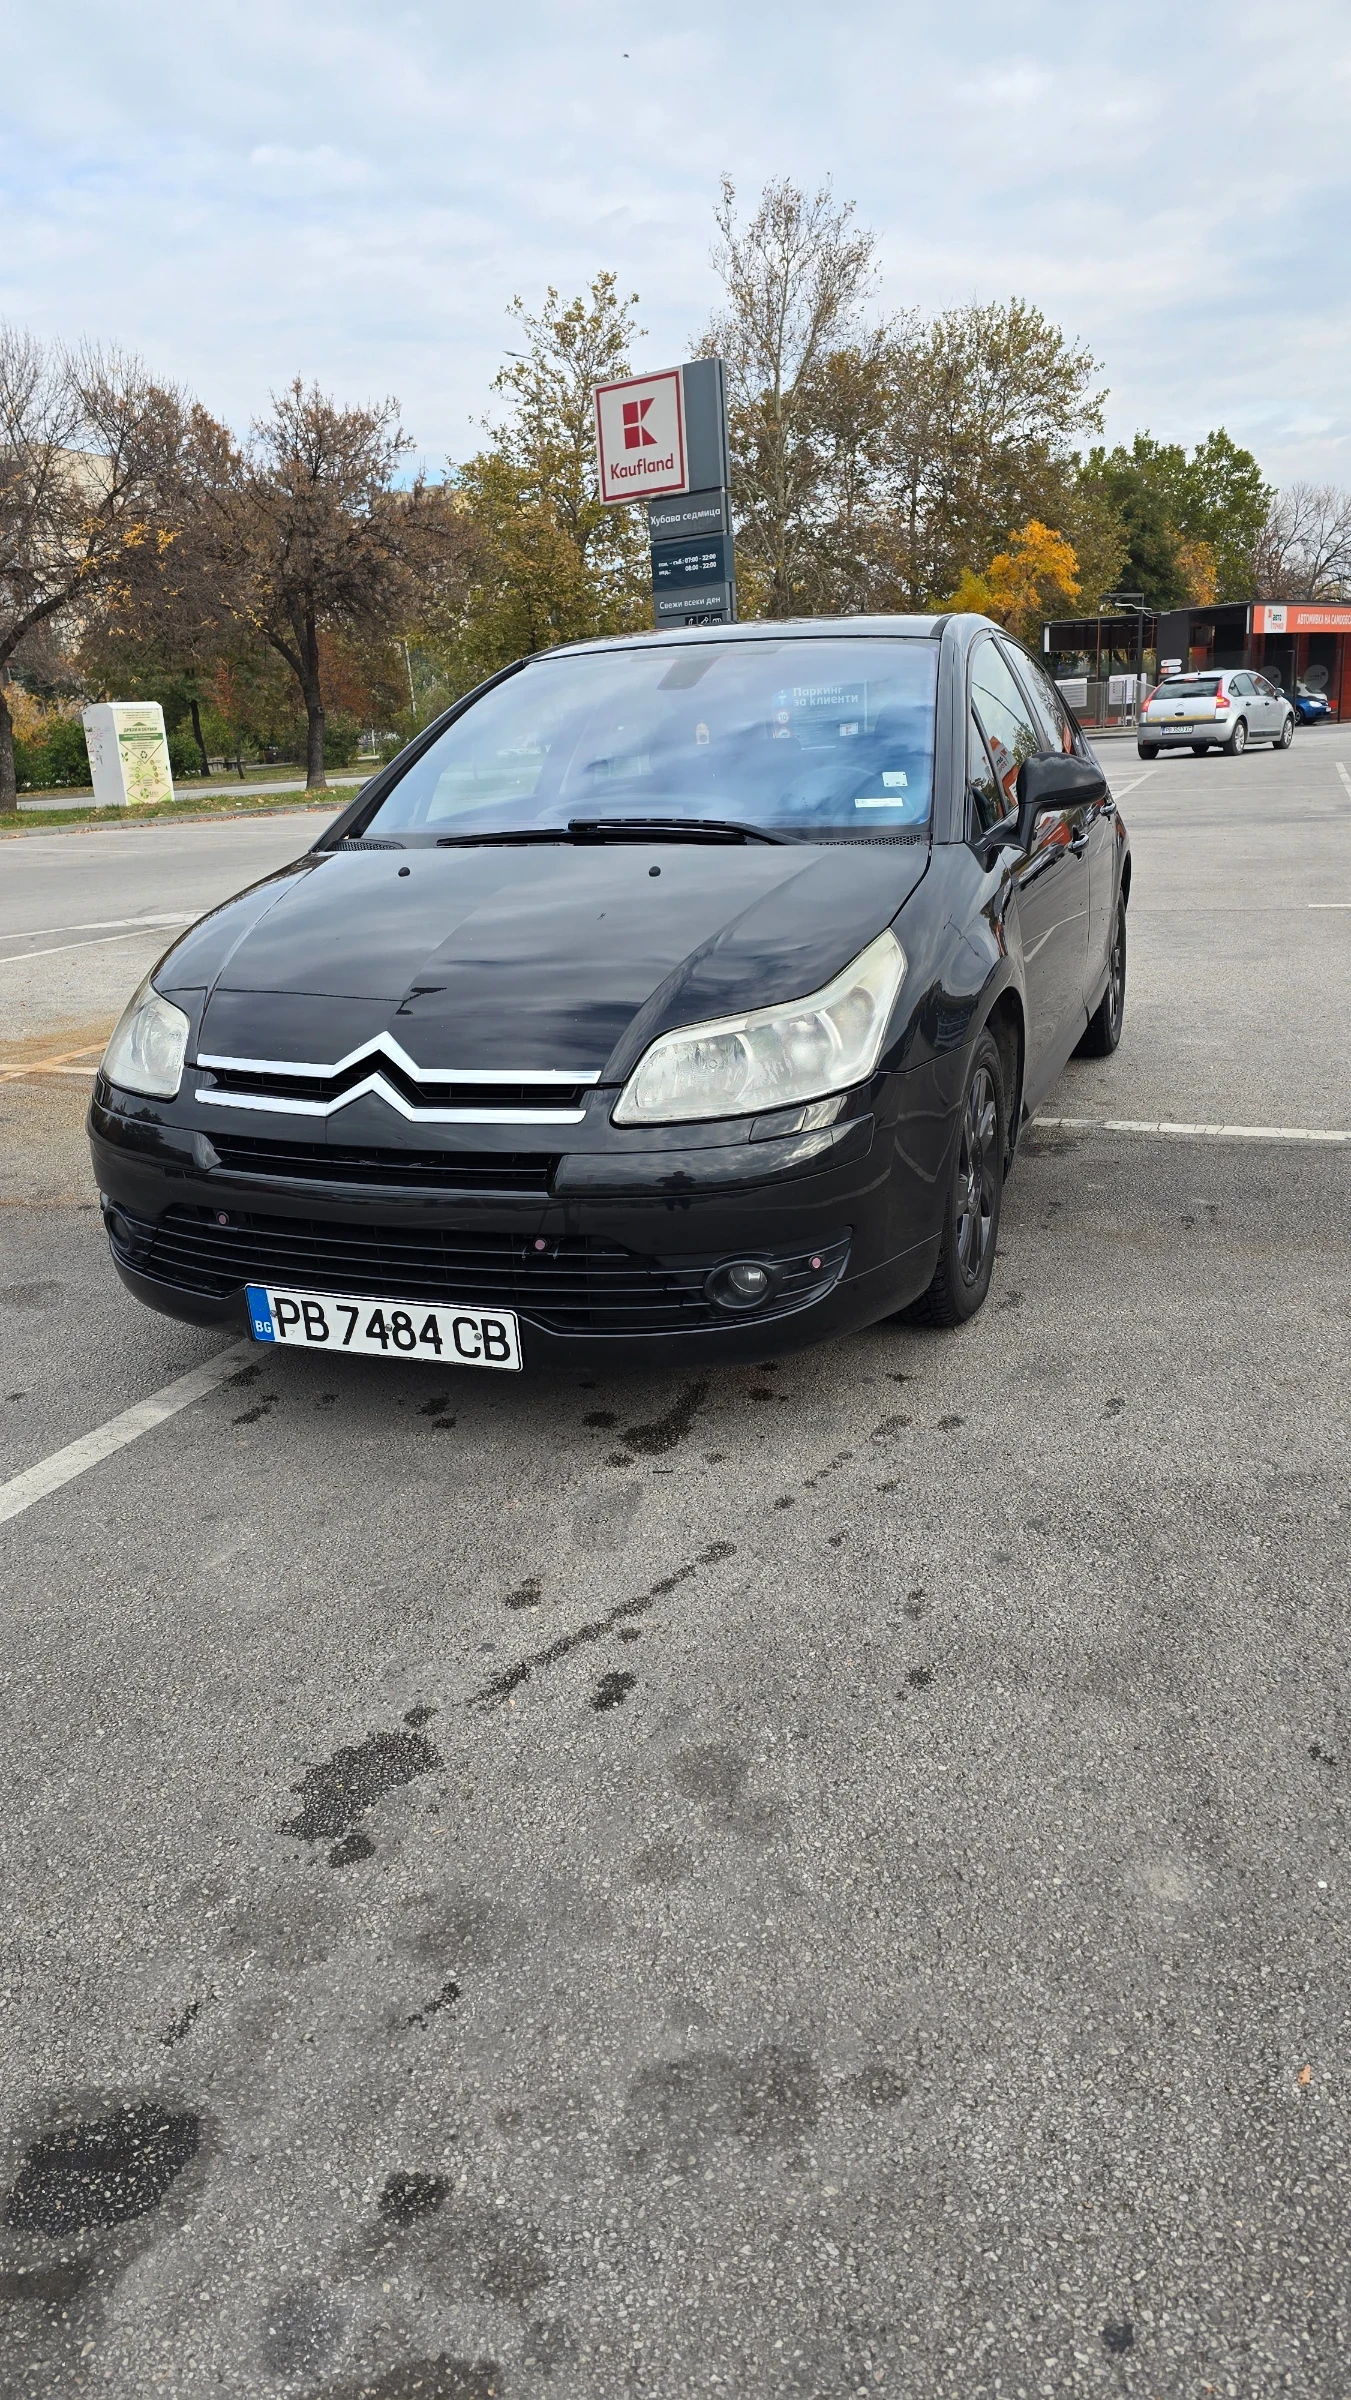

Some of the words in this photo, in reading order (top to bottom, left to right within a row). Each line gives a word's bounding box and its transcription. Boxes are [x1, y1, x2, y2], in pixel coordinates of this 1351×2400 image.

[611, 453, 674, 480] Kaufland
[650, 514, 681, 527] Хубава
[682, 508, 721, 521] седмица
[684, 556, 699, 564] 07:00
[702, 553, 717, 561] 22:00
[702, 561, 717, 569] 22:00
[659, 601, 683, 610] Свежи
[684, 599, 705, 607] всеки
[706, 597, 721, 606] ден
[1296, 613, 1324, 625] АВТОМИВКА
[1324, 613, 1331, 625] НА
[793, 687, 844, 698] Паркинг
[793, 698, 807, 707] за
[809, 694, 859, 706] клиенти
[255, 1321, 272, 1334] BG
[274, 1297, 330, 1342] PB
[336, 1304, 444, 1355] 7484
[452, 1316, 511, 1362] CB
